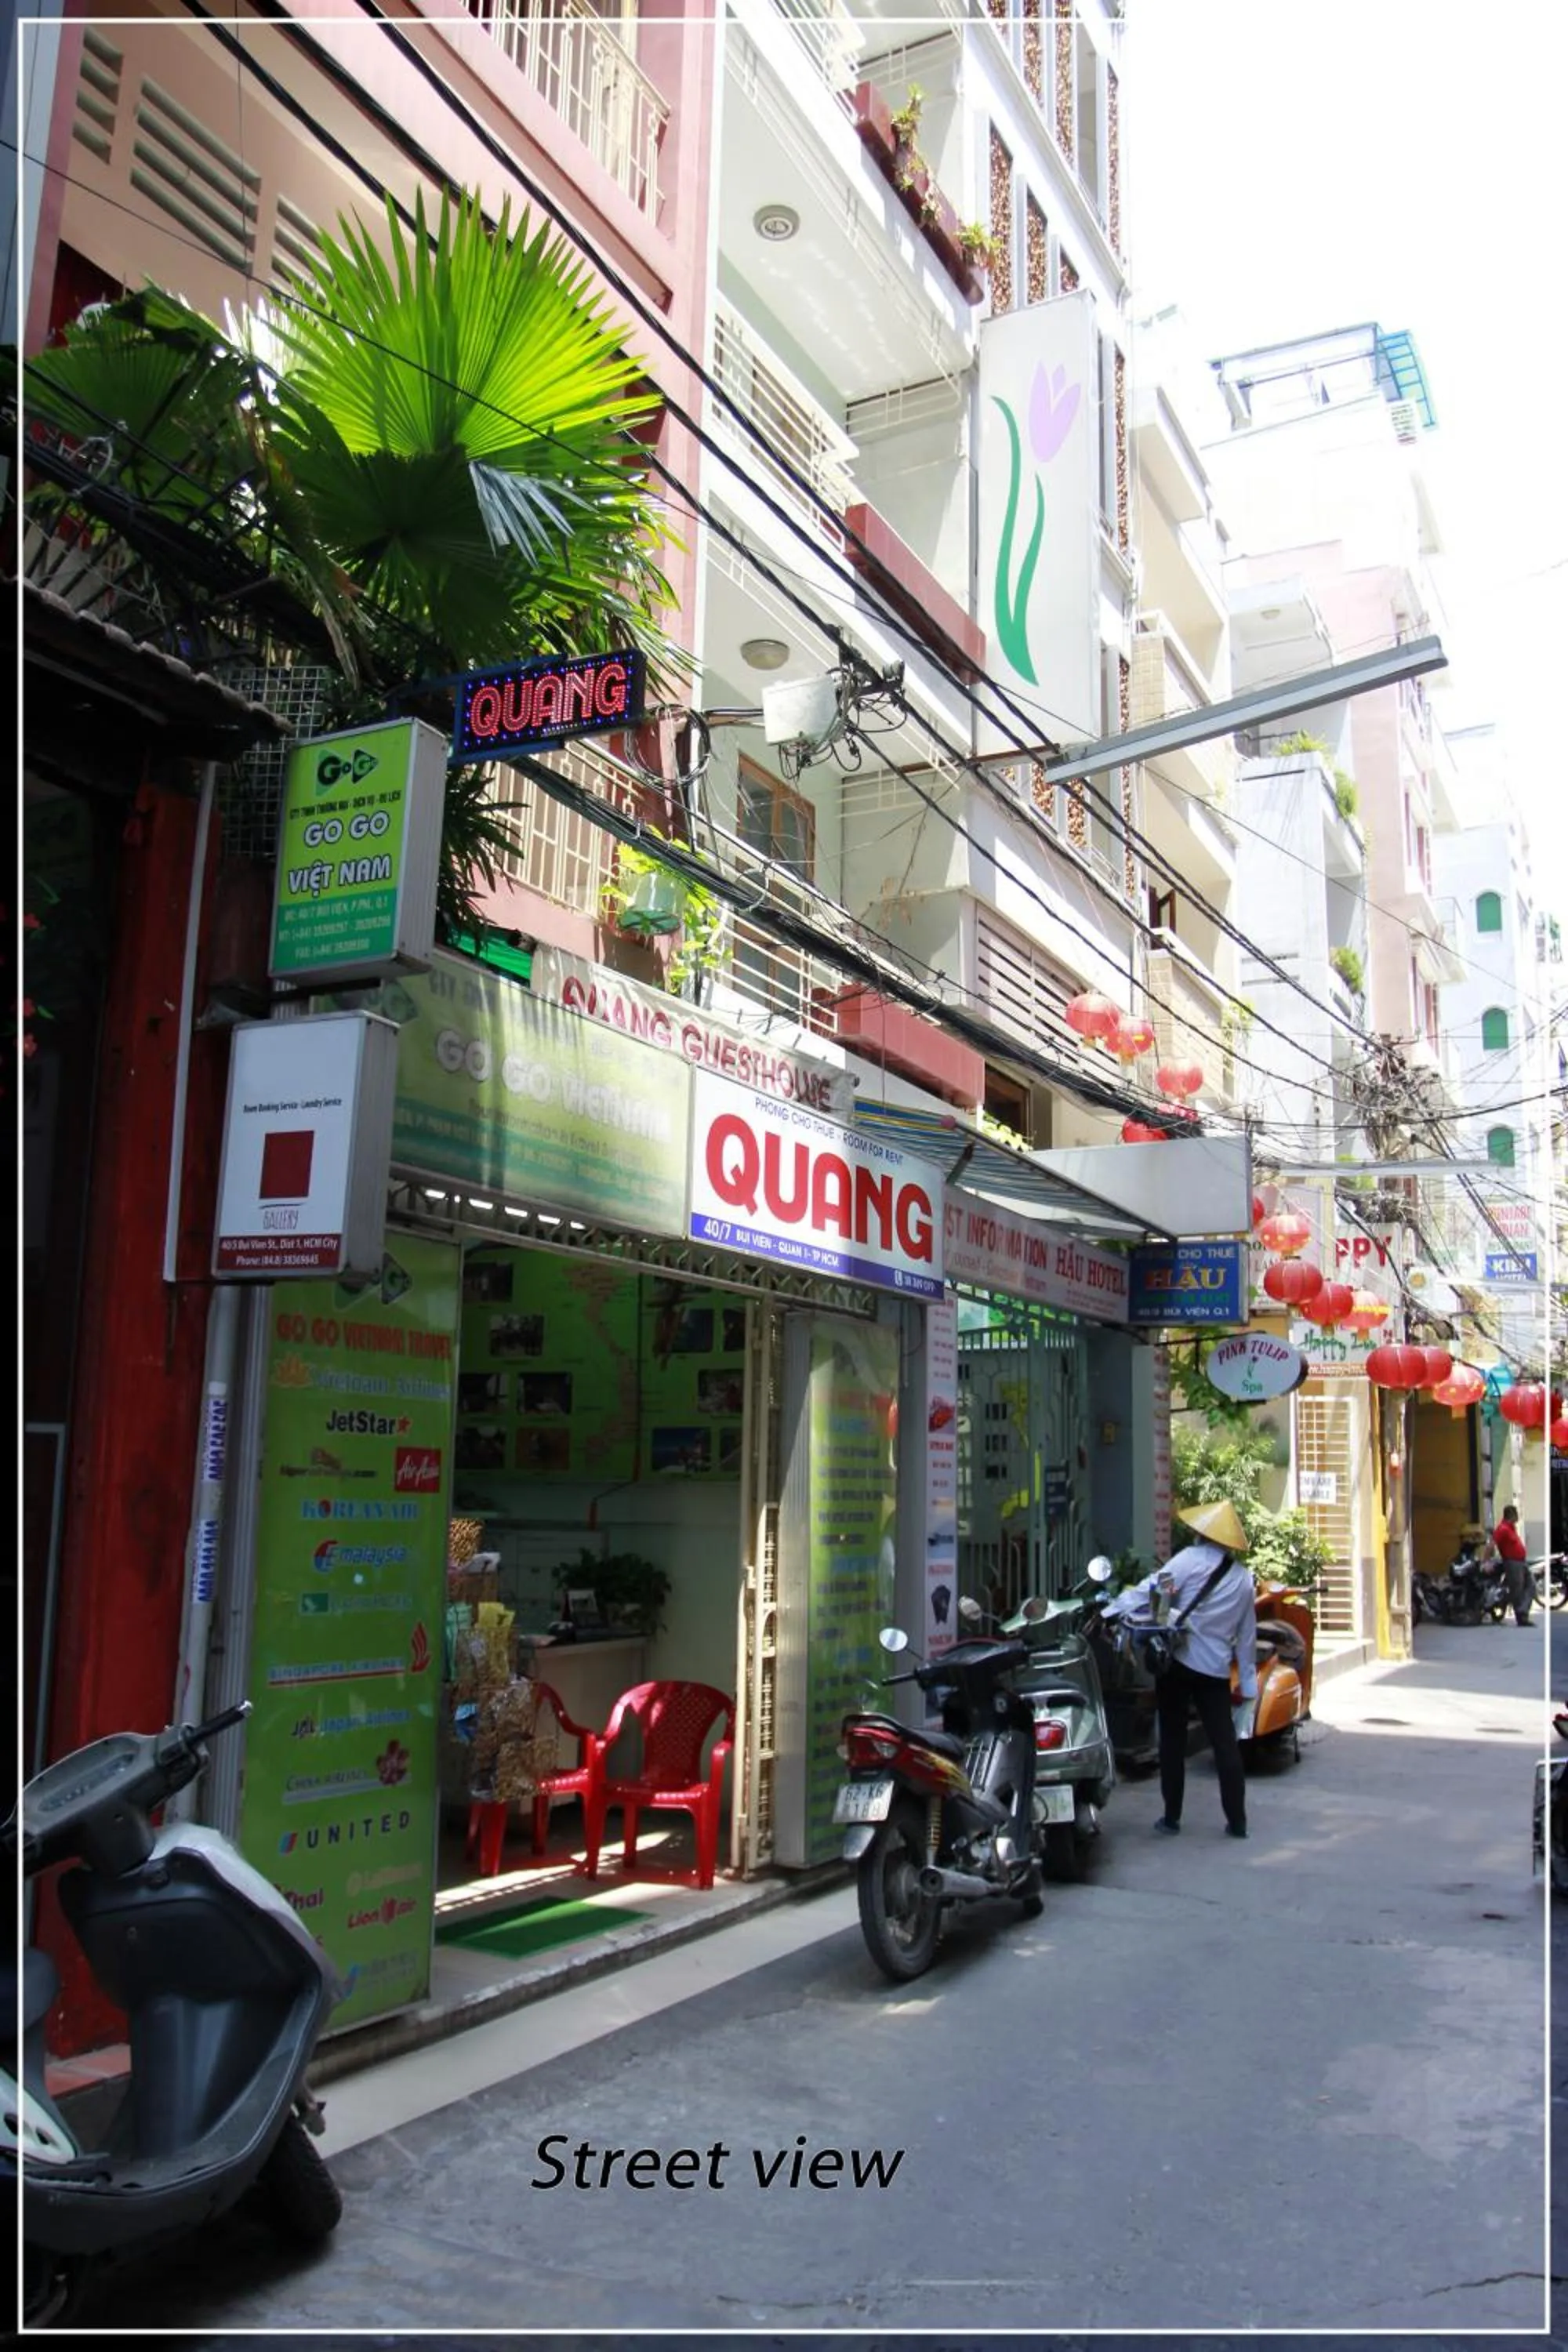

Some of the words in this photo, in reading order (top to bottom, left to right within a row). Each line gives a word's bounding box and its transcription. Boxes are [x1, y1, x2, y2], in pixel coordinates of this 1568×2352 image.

[470, 663, 626, 737] QUANG
[304, 818, 343, 848] GO
[349, 810, 390, 840] GO
[289, 859, 334, 897] VIỆT
[339, 854, 391, 886] NAM
[436, 1029, 493, 1083] GO
[503, 1051, 550, 1105] GO
[791, 1112, 811, 1130] CHO
[843, 1131, 867, 1152] ROOM
[868, 1143, 884, 1158] FOR
[885, 1151, 903, 1166] RENT
[706, 1112, 934, 1265] QUANG
[322, 1236, 338, 1250] City
[704, 1218, 731, 1241] 40/7
[967, 1212, 1048, 1270] INFORMATION
[1087, 1258, 1127, 1296] HOTEL
[1178, 1248, 1202, 1260] CHO
[1336, 1236, 1392, 1269] PPY
[1218, 1340, 1247, 1365] PINK
[1251, 1339, 1289, 1362] TULIP
[1241, 1380, 1263, 1394] Spa
[326, 1410, 396, 1436] JetStar
[307, 1809, 411, 1849] UNITED
[347, 1908, 379, 1930] Lion
